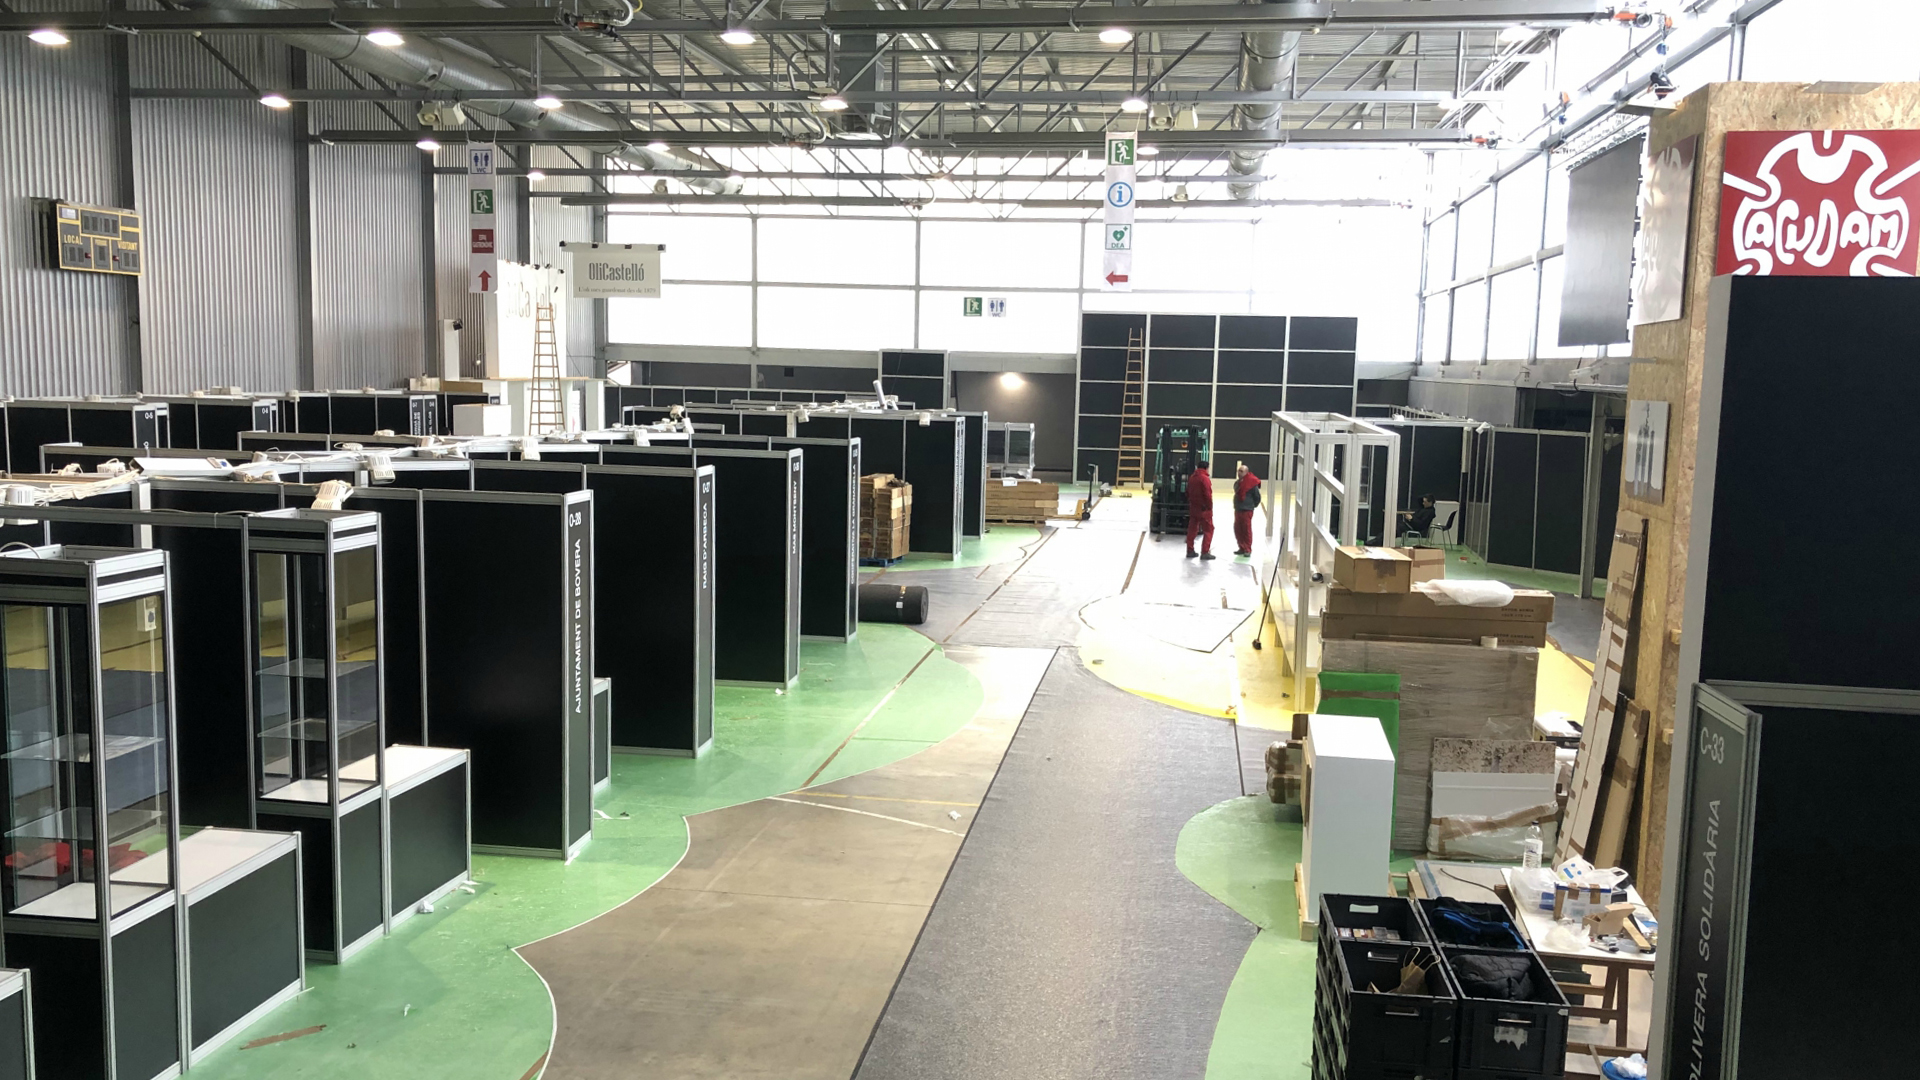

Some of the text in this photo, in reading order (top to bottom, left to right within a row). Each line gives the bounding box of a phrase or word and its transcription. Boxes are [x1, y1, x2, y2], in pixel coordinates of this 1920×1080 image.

[63, 234, 83, 245] LOCAL
[1745, 199, 1900, 267] ACUDAM
[588, 262, 645, 281] OliCastelló
[569, 511, 582, 527] O-28
[574, 599, 582, 619] DE
[574, 622, 582, 714] AJUNTAMENT
[1700, 726, 1725, 765] C-33
[1699, 799, 1721, 962] SOLIDÀRIA
